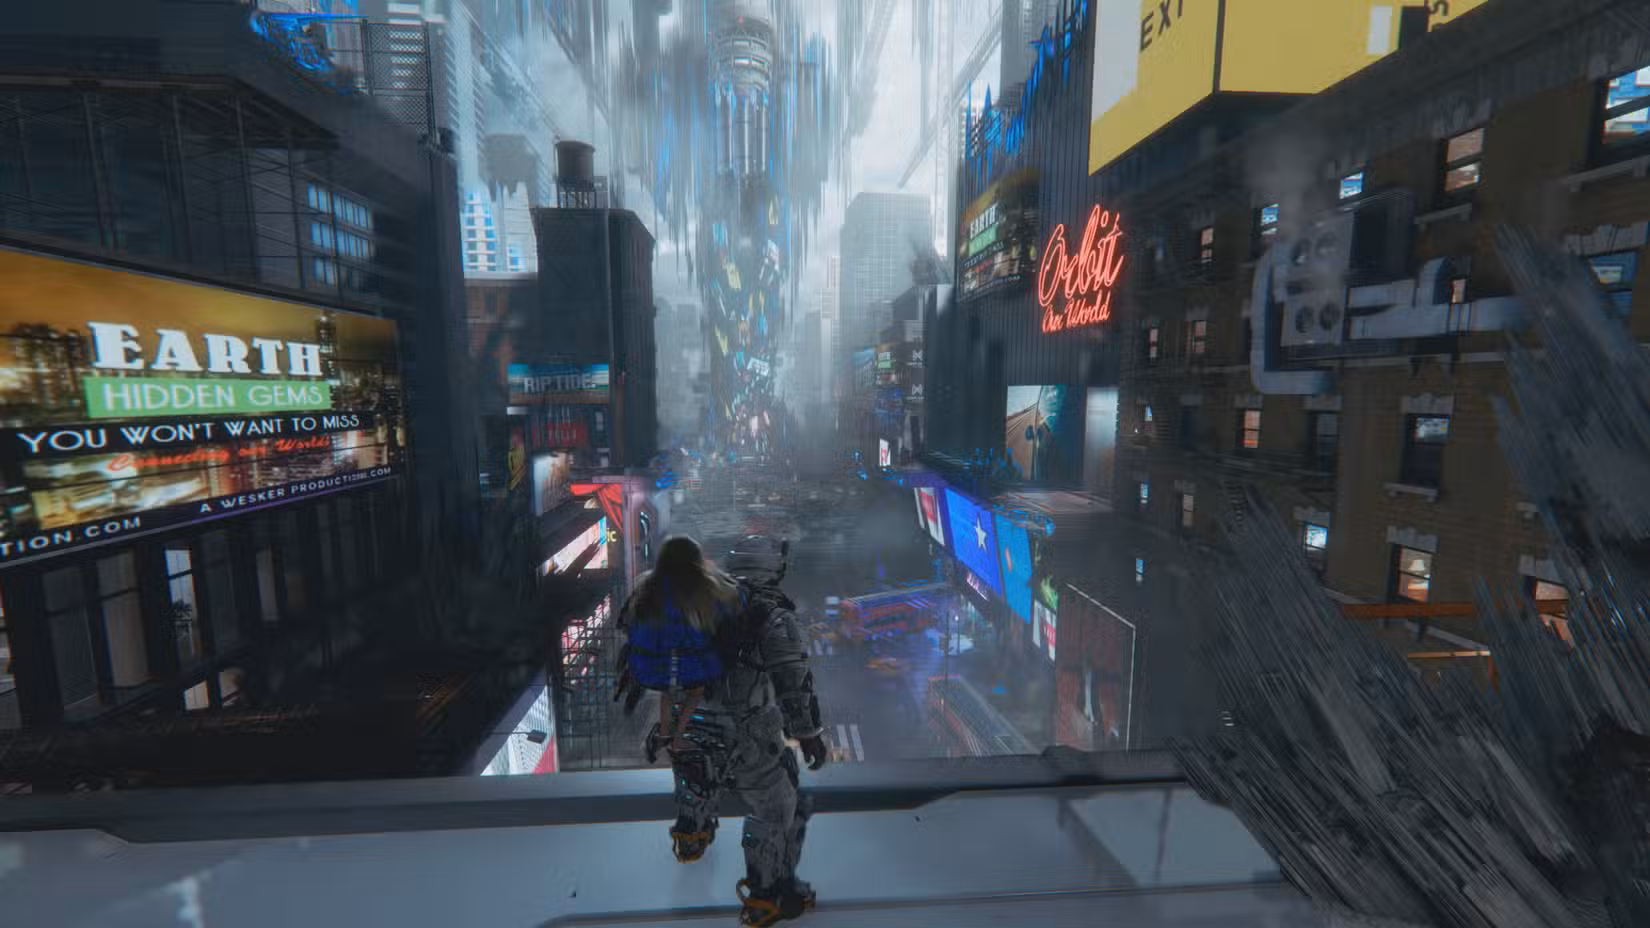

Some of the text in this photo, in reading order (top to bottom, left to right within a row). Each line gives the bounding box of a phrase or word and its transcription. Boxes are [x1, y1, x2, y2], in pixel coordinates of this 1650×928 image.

[1065, 289, 1111, 328] World
[87, 320, 323, 377] EARTH
[102, 383, 323, 412] HIDDEN GEMS
[16, 414, 360, 454] YOU WON'T WANT TO MISS
[200, 503, 212, 513] A
[220, 488, 285, 508] WESKER
